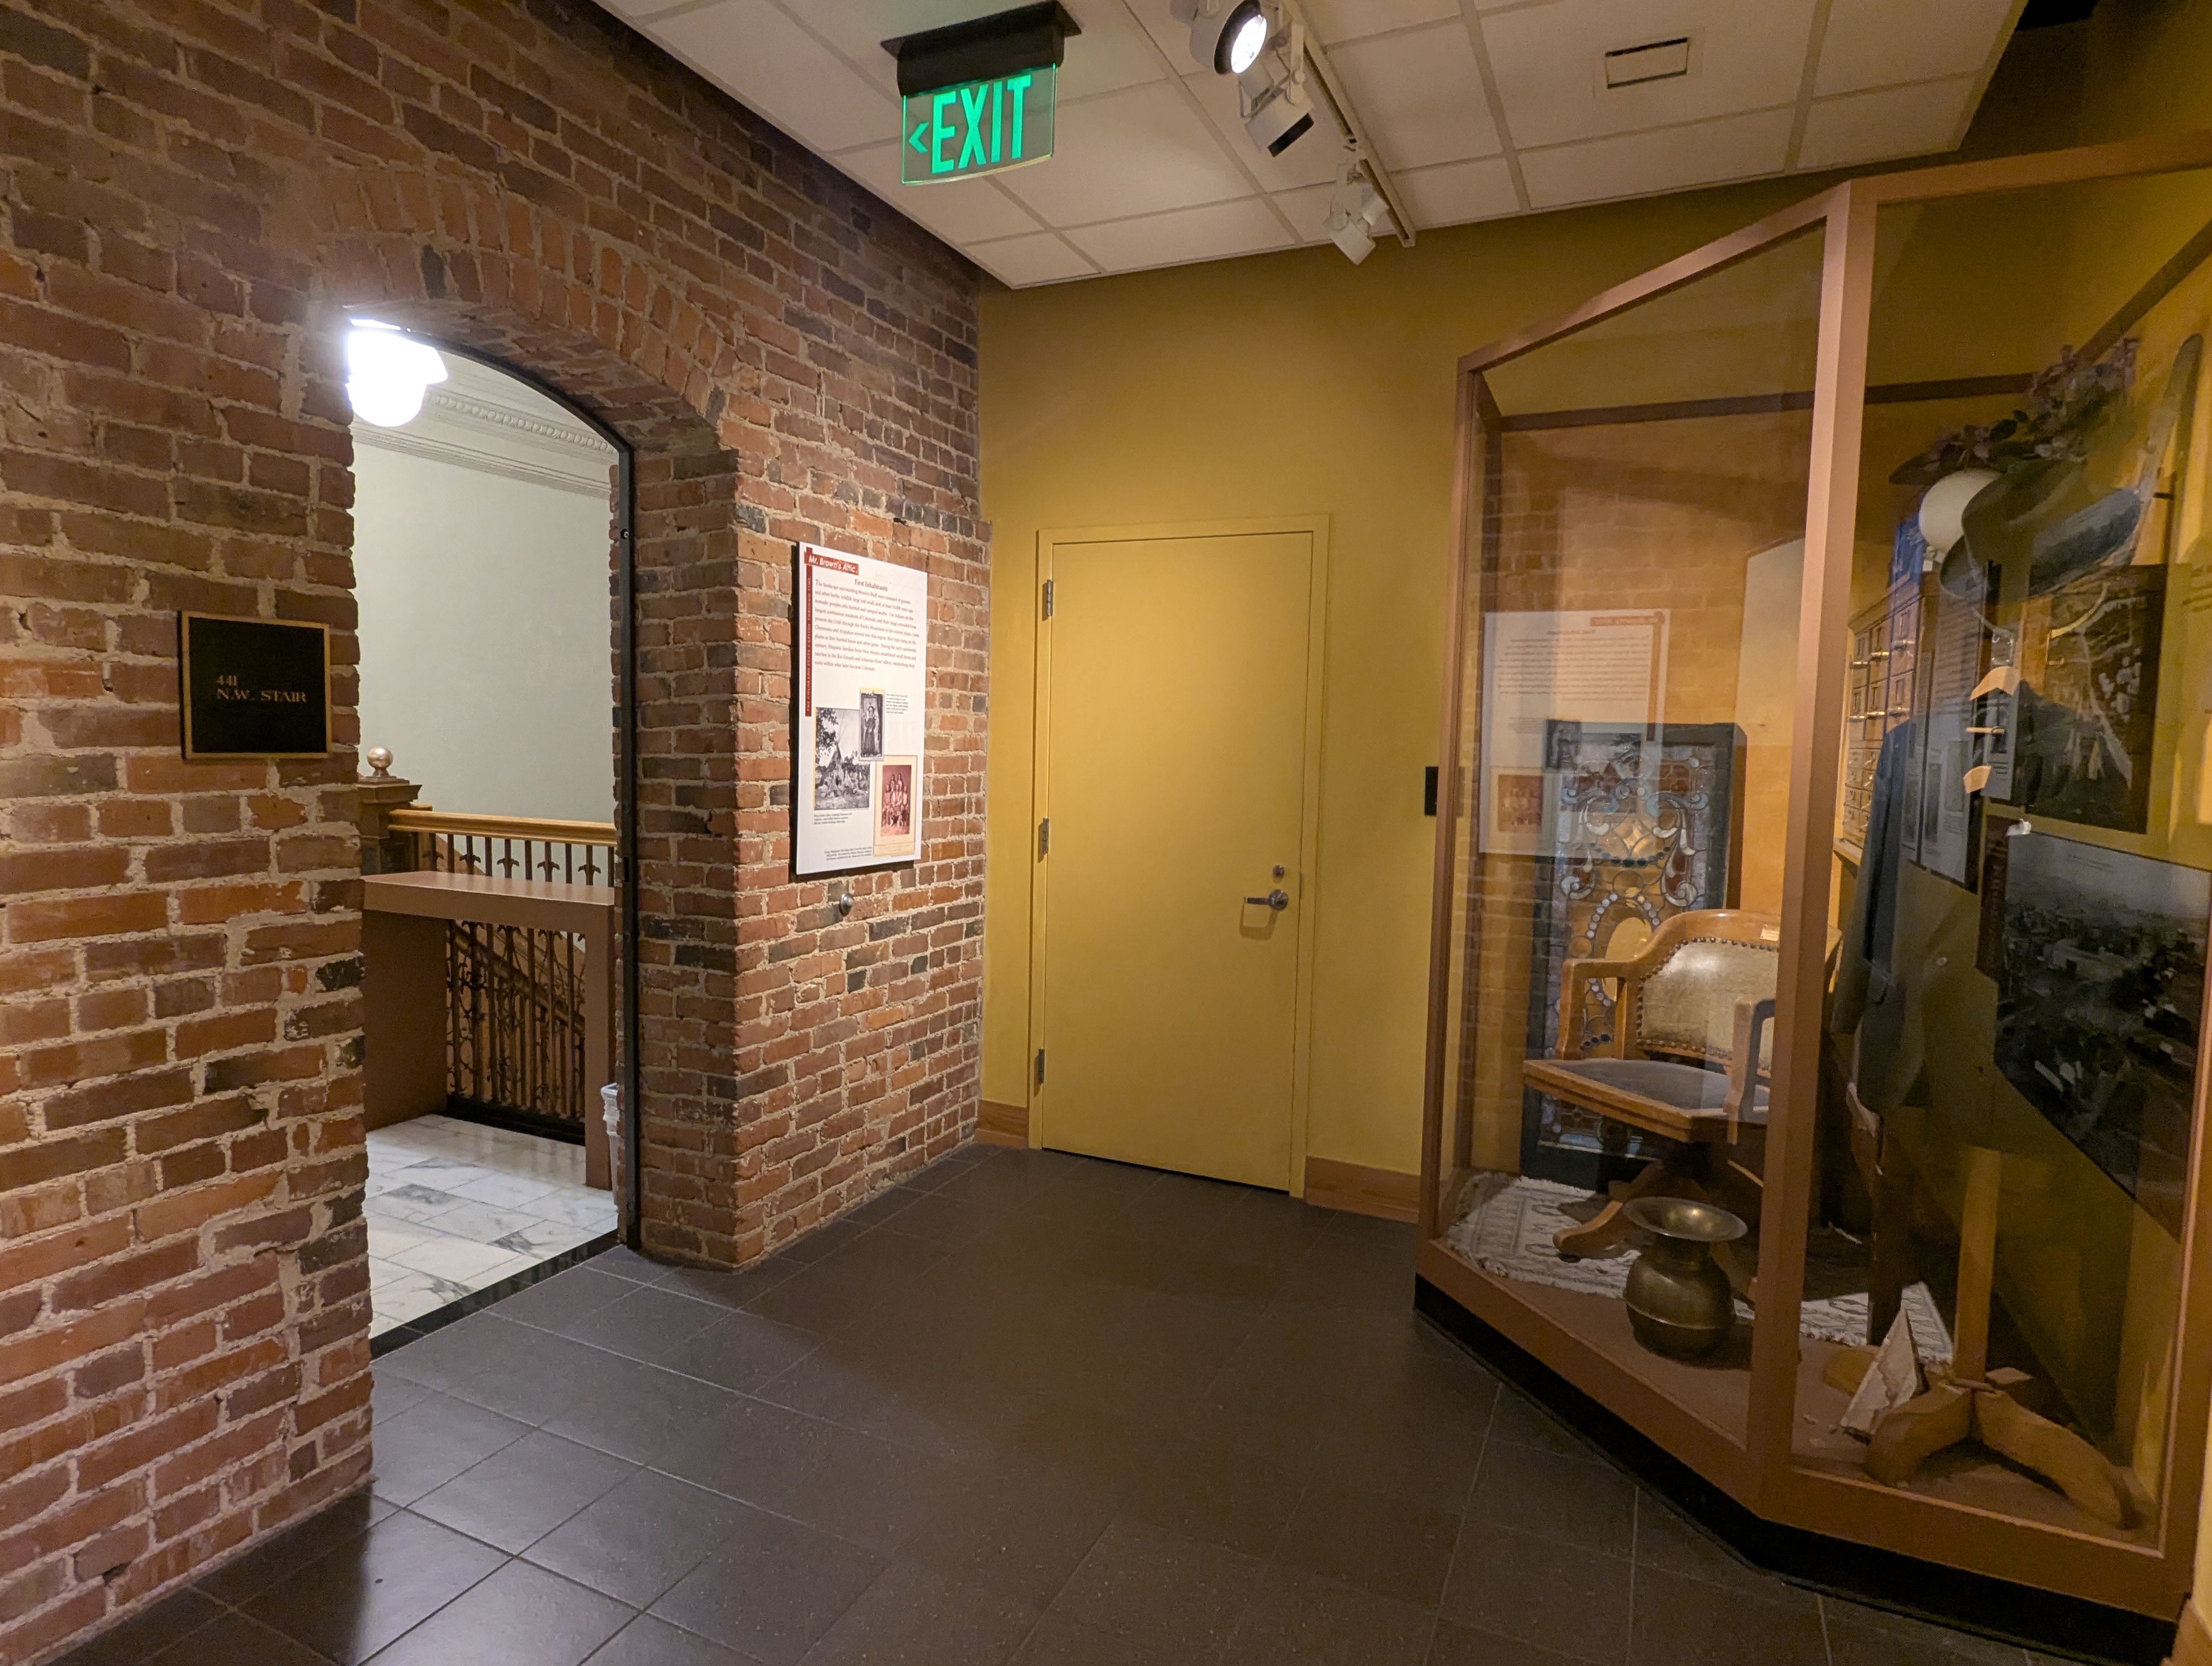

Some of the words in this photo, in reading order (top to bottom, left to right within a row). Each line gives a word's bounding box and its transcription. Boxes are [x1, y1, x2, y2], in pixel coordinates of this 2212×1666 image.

[931, 74, 1032, 174] EXIT
[808, 555, 819, 565] Mr.
[819, 557, 841, 570] Brown's
[865, 580, 888, 592] Inhabitants
[260, 690, 307, 703] STAIR
